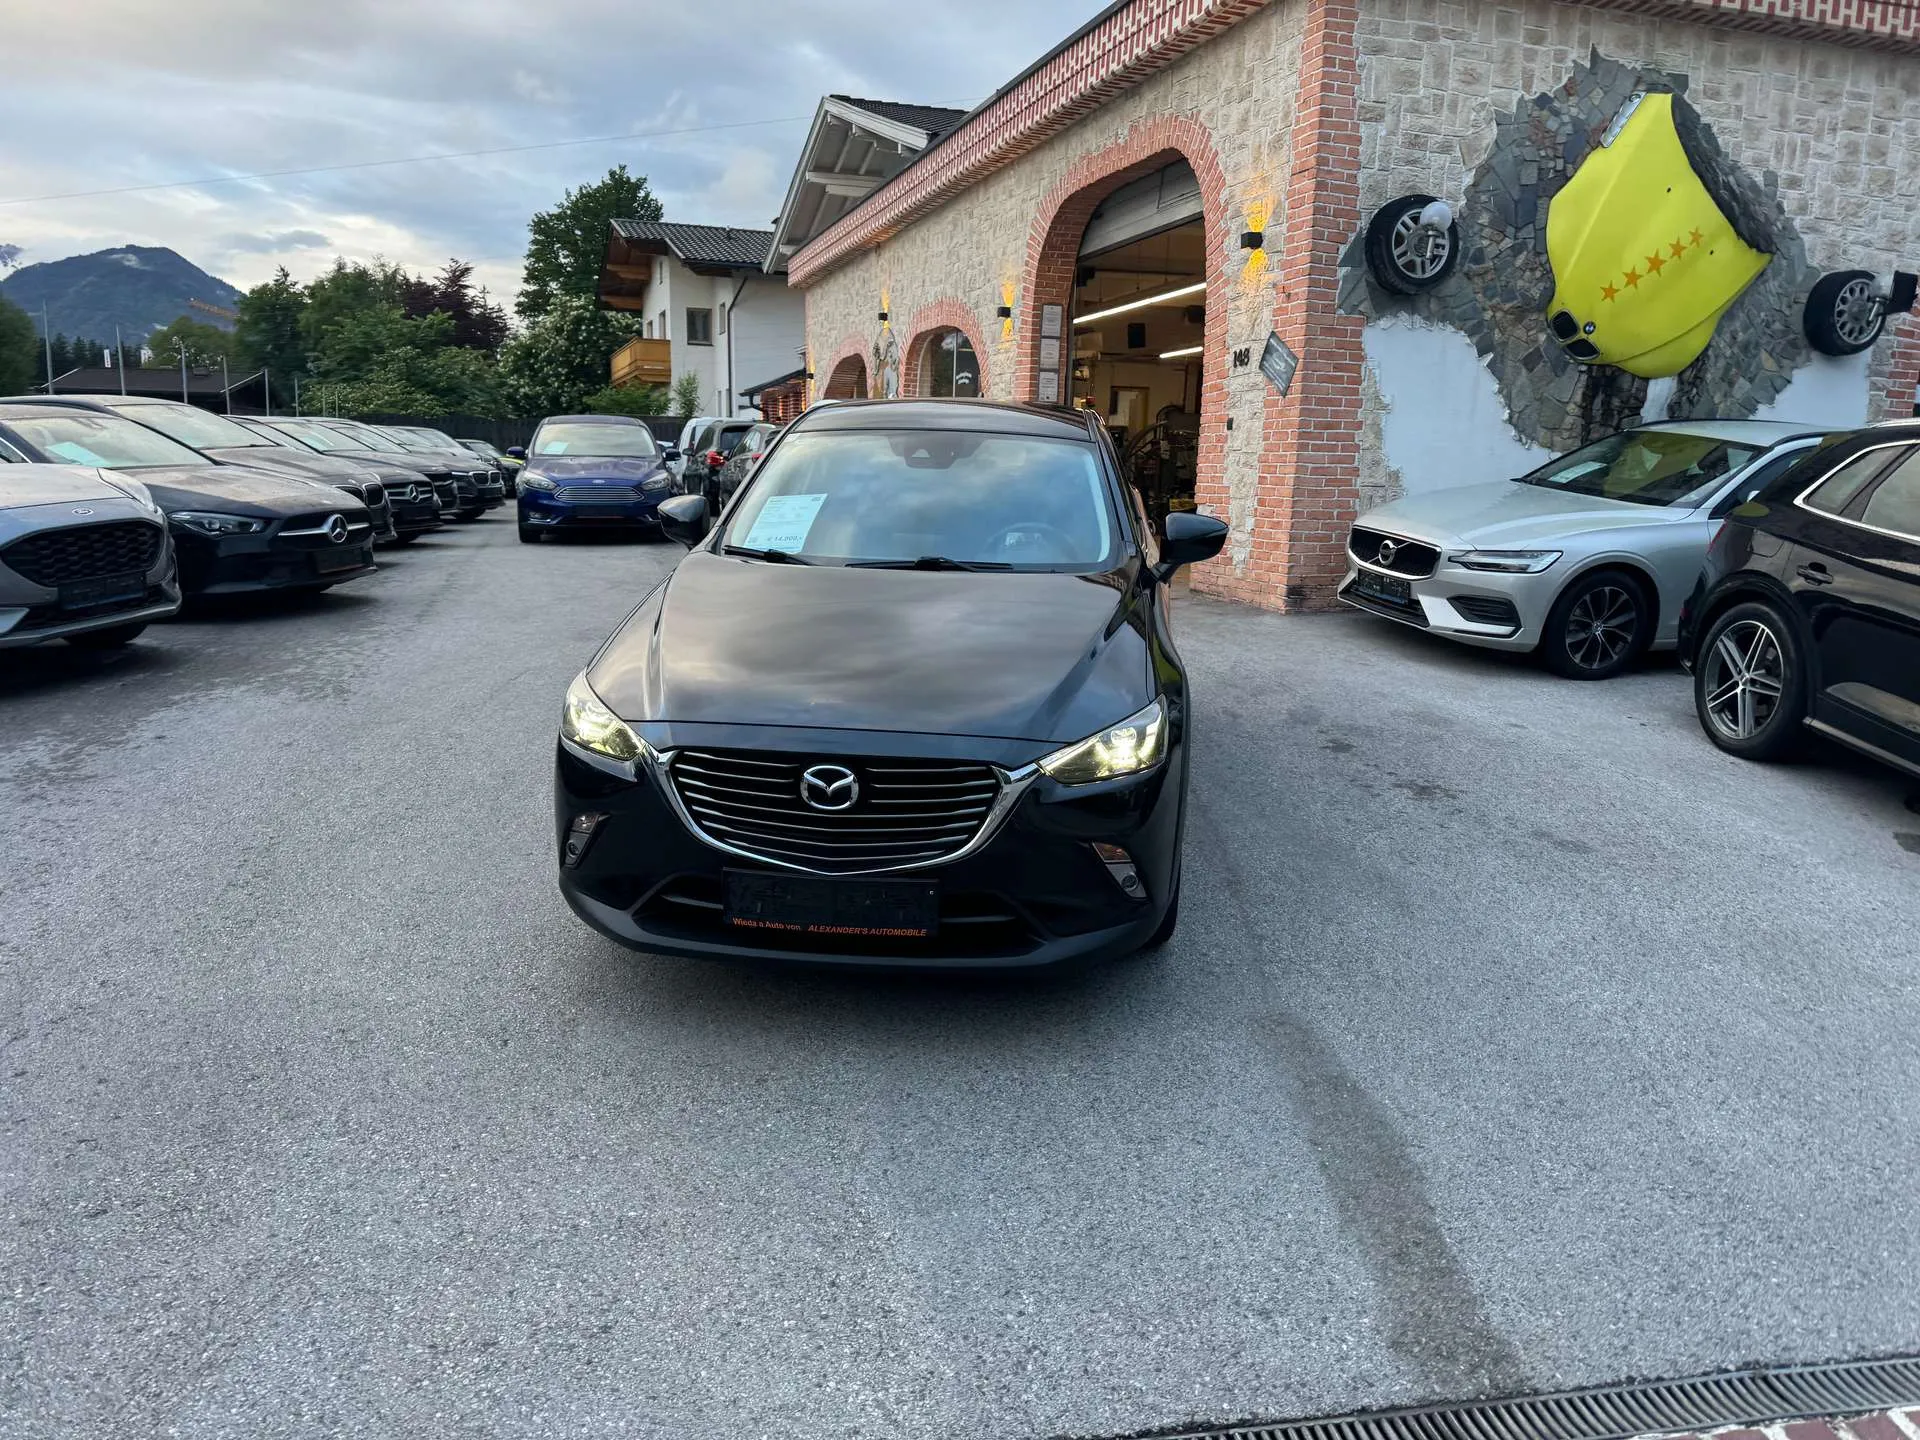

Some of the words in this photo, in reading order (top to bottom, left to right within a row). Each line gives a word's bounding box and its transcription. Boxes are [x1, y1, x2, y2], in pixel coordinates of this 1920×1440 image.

[733, 917, 757, 928] Wieda
[765, 920, 785, 930] Auto
[786, 923, 802, 932] von
[808, 924, 869, 935] ALEXANDER'S
[869, 928, 928, 936] AUTOMOBILE
